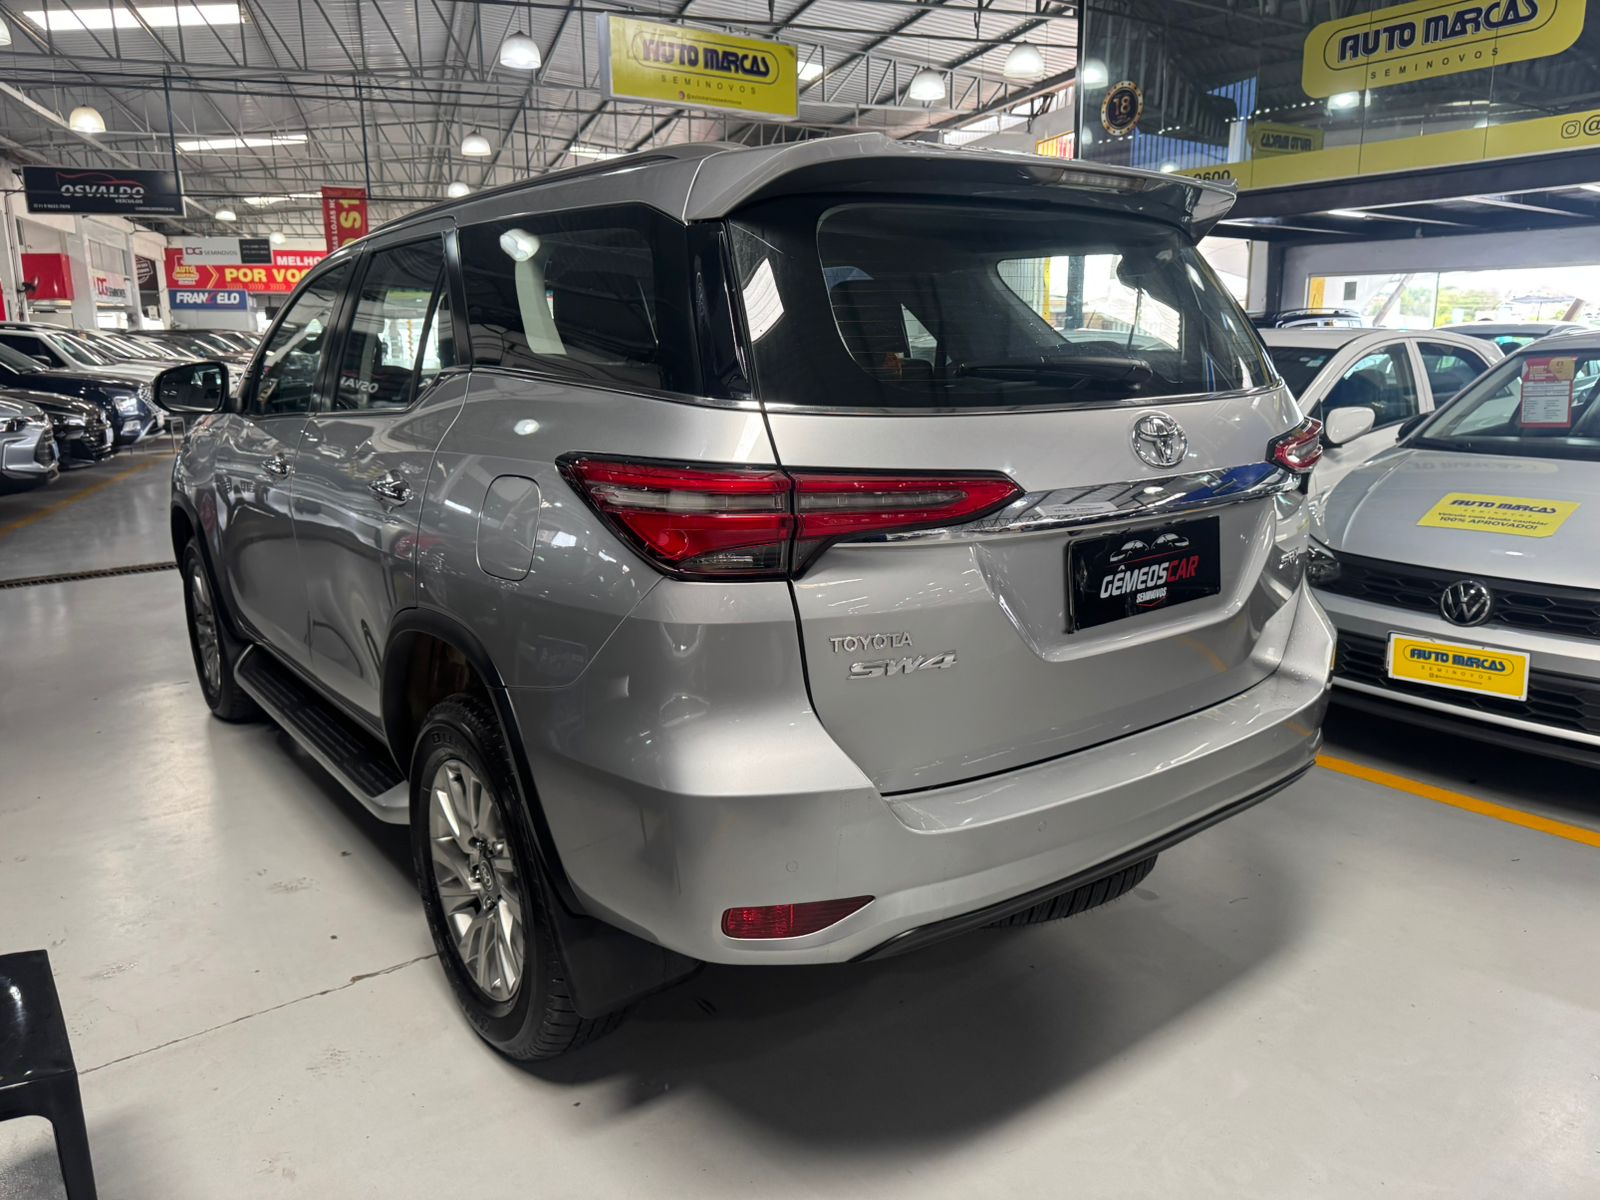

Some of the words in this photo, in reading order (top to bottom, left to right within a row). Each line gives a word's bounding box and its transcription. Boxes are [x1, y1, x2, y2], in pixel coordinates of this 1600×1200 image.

[1338, 21, 1416, 62] AUTO
[1423, 0, 1539, 45] MARCAS
[642, 38, 699, 67] AUTO
[703, 47, 770, 77] MARCAS
[1371, 47, 1500, 80] SEMINOVOS
[661, 75, 756, 95] SEMINOVOS
[1113, 95, 1131, 115] 18
[60, 184, 145, 198] OSVALDO
[329, 210, 337, 234] LOJAS
[225, 268, 267, 282] POR
[1450, 499, 1495, 508] AUTO
[1496, 503, 1557, 514] MARCAS
[1468, 518, 1538, 530] APROVADO!
[1135, 586, 1167, 604] SEMINOVOS
[829, 632, 913, 653] TOYOTA
[847, 651, 957, 681] SW4
[1410, 648, 1449, 663] AUTO
[1452, 654, 1506, 672] MARCAS
[1421, 665, 1492, 681] SEMINOVOS
